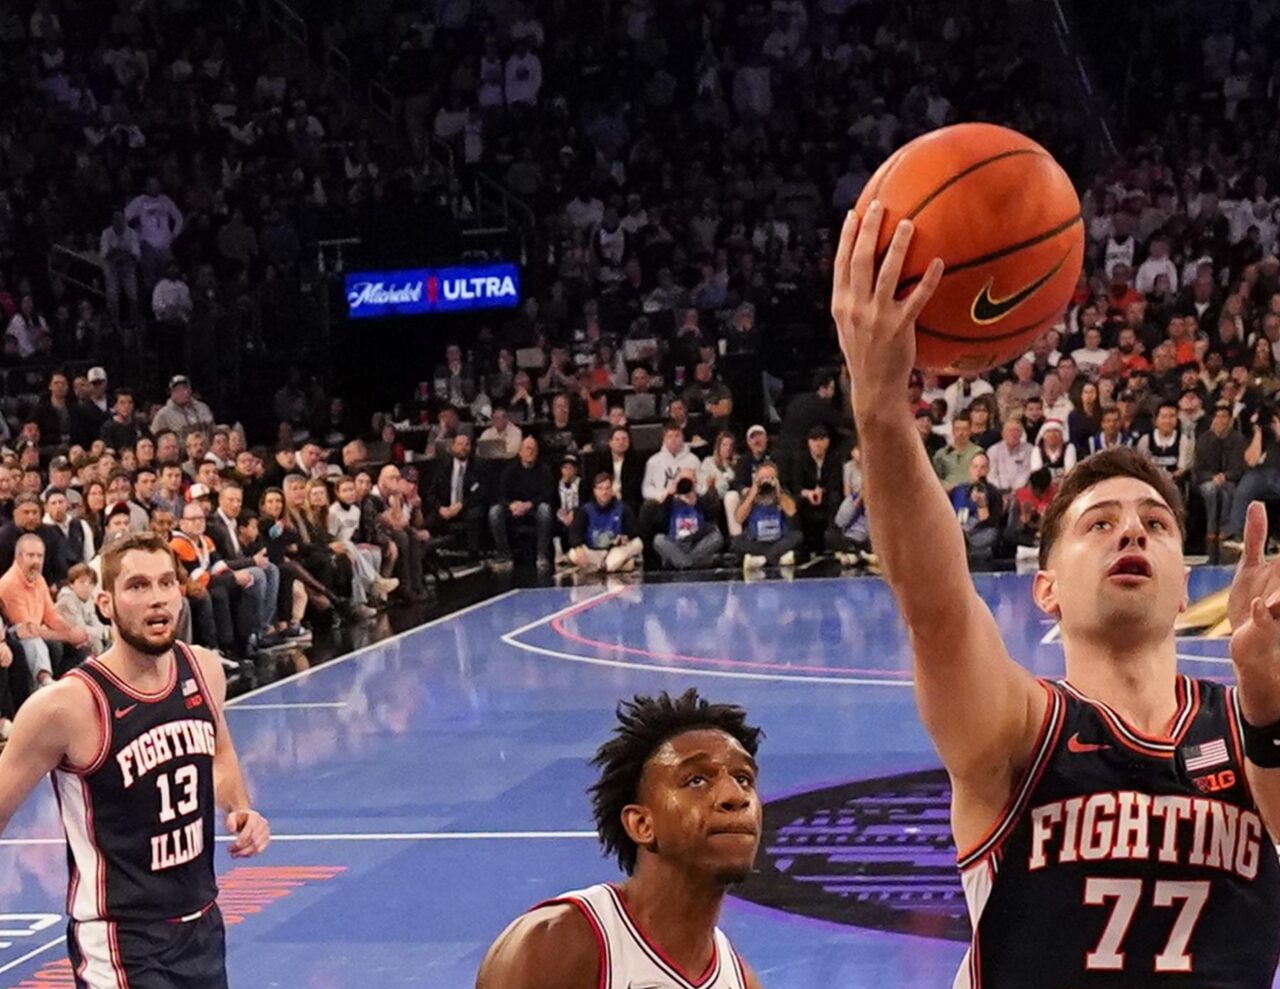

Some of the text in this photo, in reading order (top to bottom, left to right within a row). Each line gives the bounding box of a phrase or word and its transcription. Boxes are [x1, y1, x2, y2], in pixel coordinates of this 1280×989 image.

[444, 276, 516, 300] ULTRA
[115, 719, 215, 789] FIGHTING
[156, 764, 199, 823] 13
[150, 816, 204, 871] ILLIN
[1028, 790, 1262, 880] FIGHTING
[1083, 877, 1211, 972] 77
